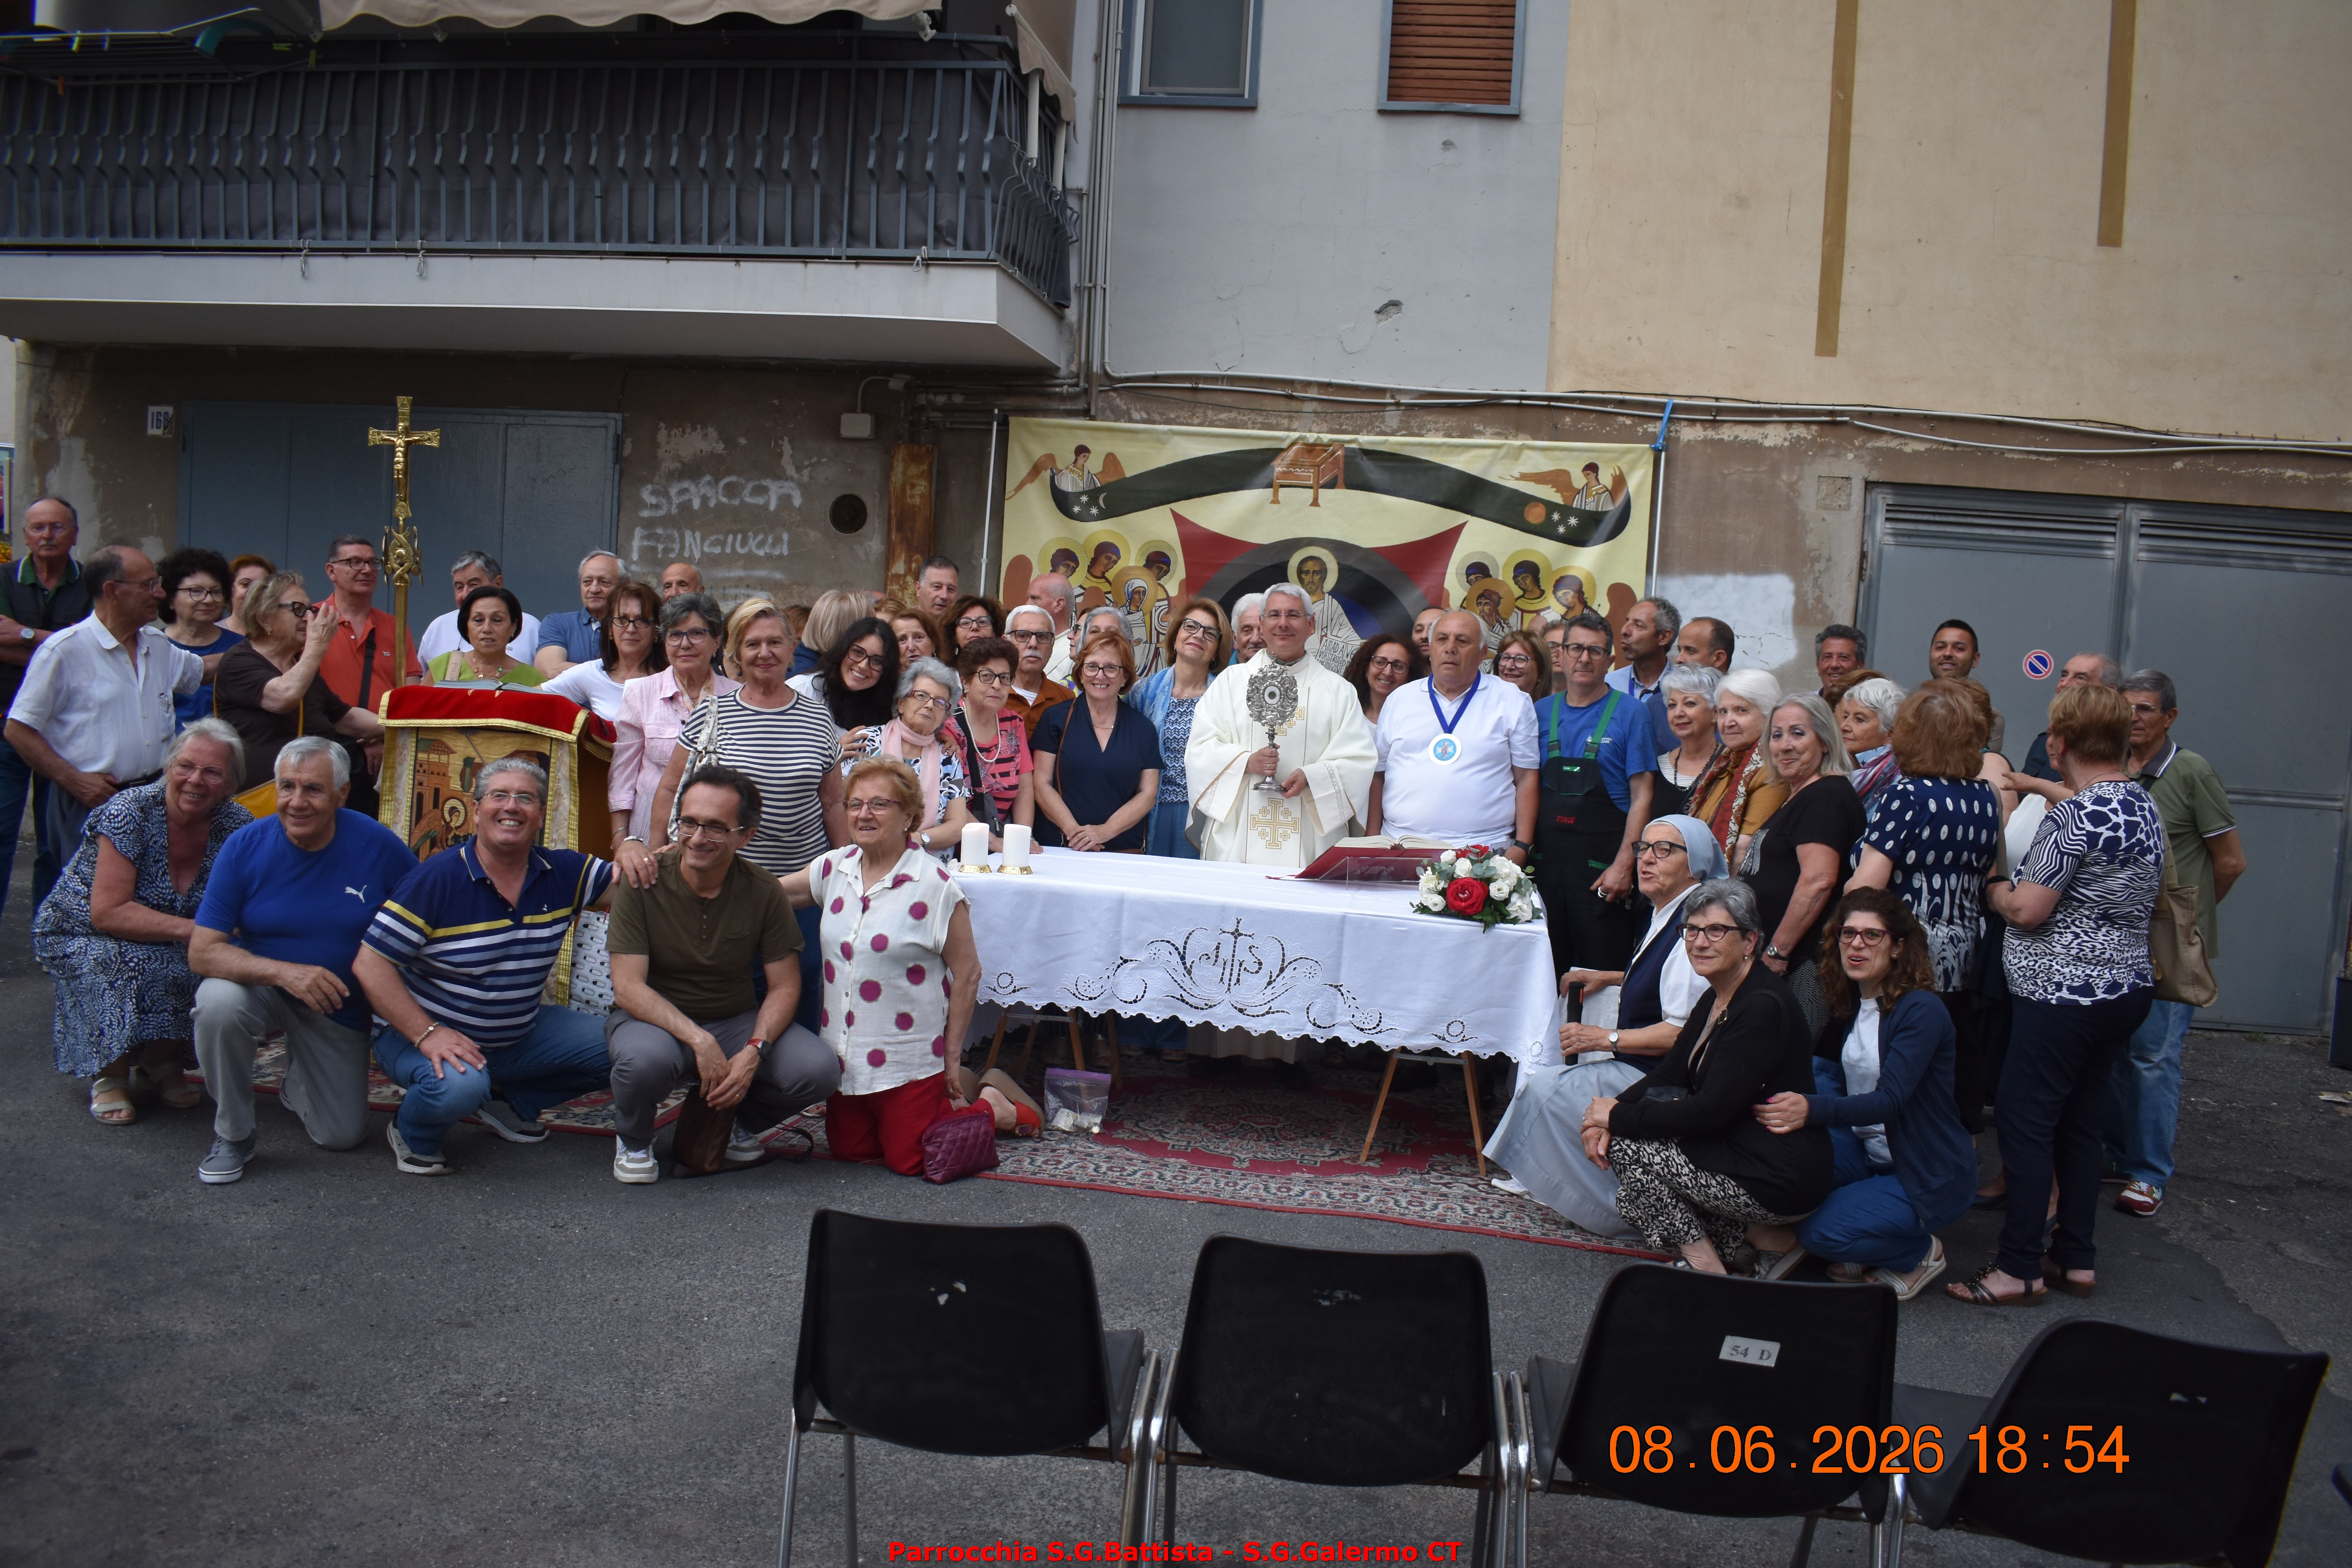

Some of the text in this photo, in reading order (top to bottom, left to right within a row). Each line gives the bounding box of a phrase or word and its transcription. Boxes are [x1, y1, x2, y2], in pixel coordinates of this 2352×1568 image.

[639, 474, 802, 517] SPACCA
[1321, 639, 1339, 653] AMAD
[1319, 650, 1342, 664] VUESTROS
[1730, 1345, 1772, 1360] 54 D
